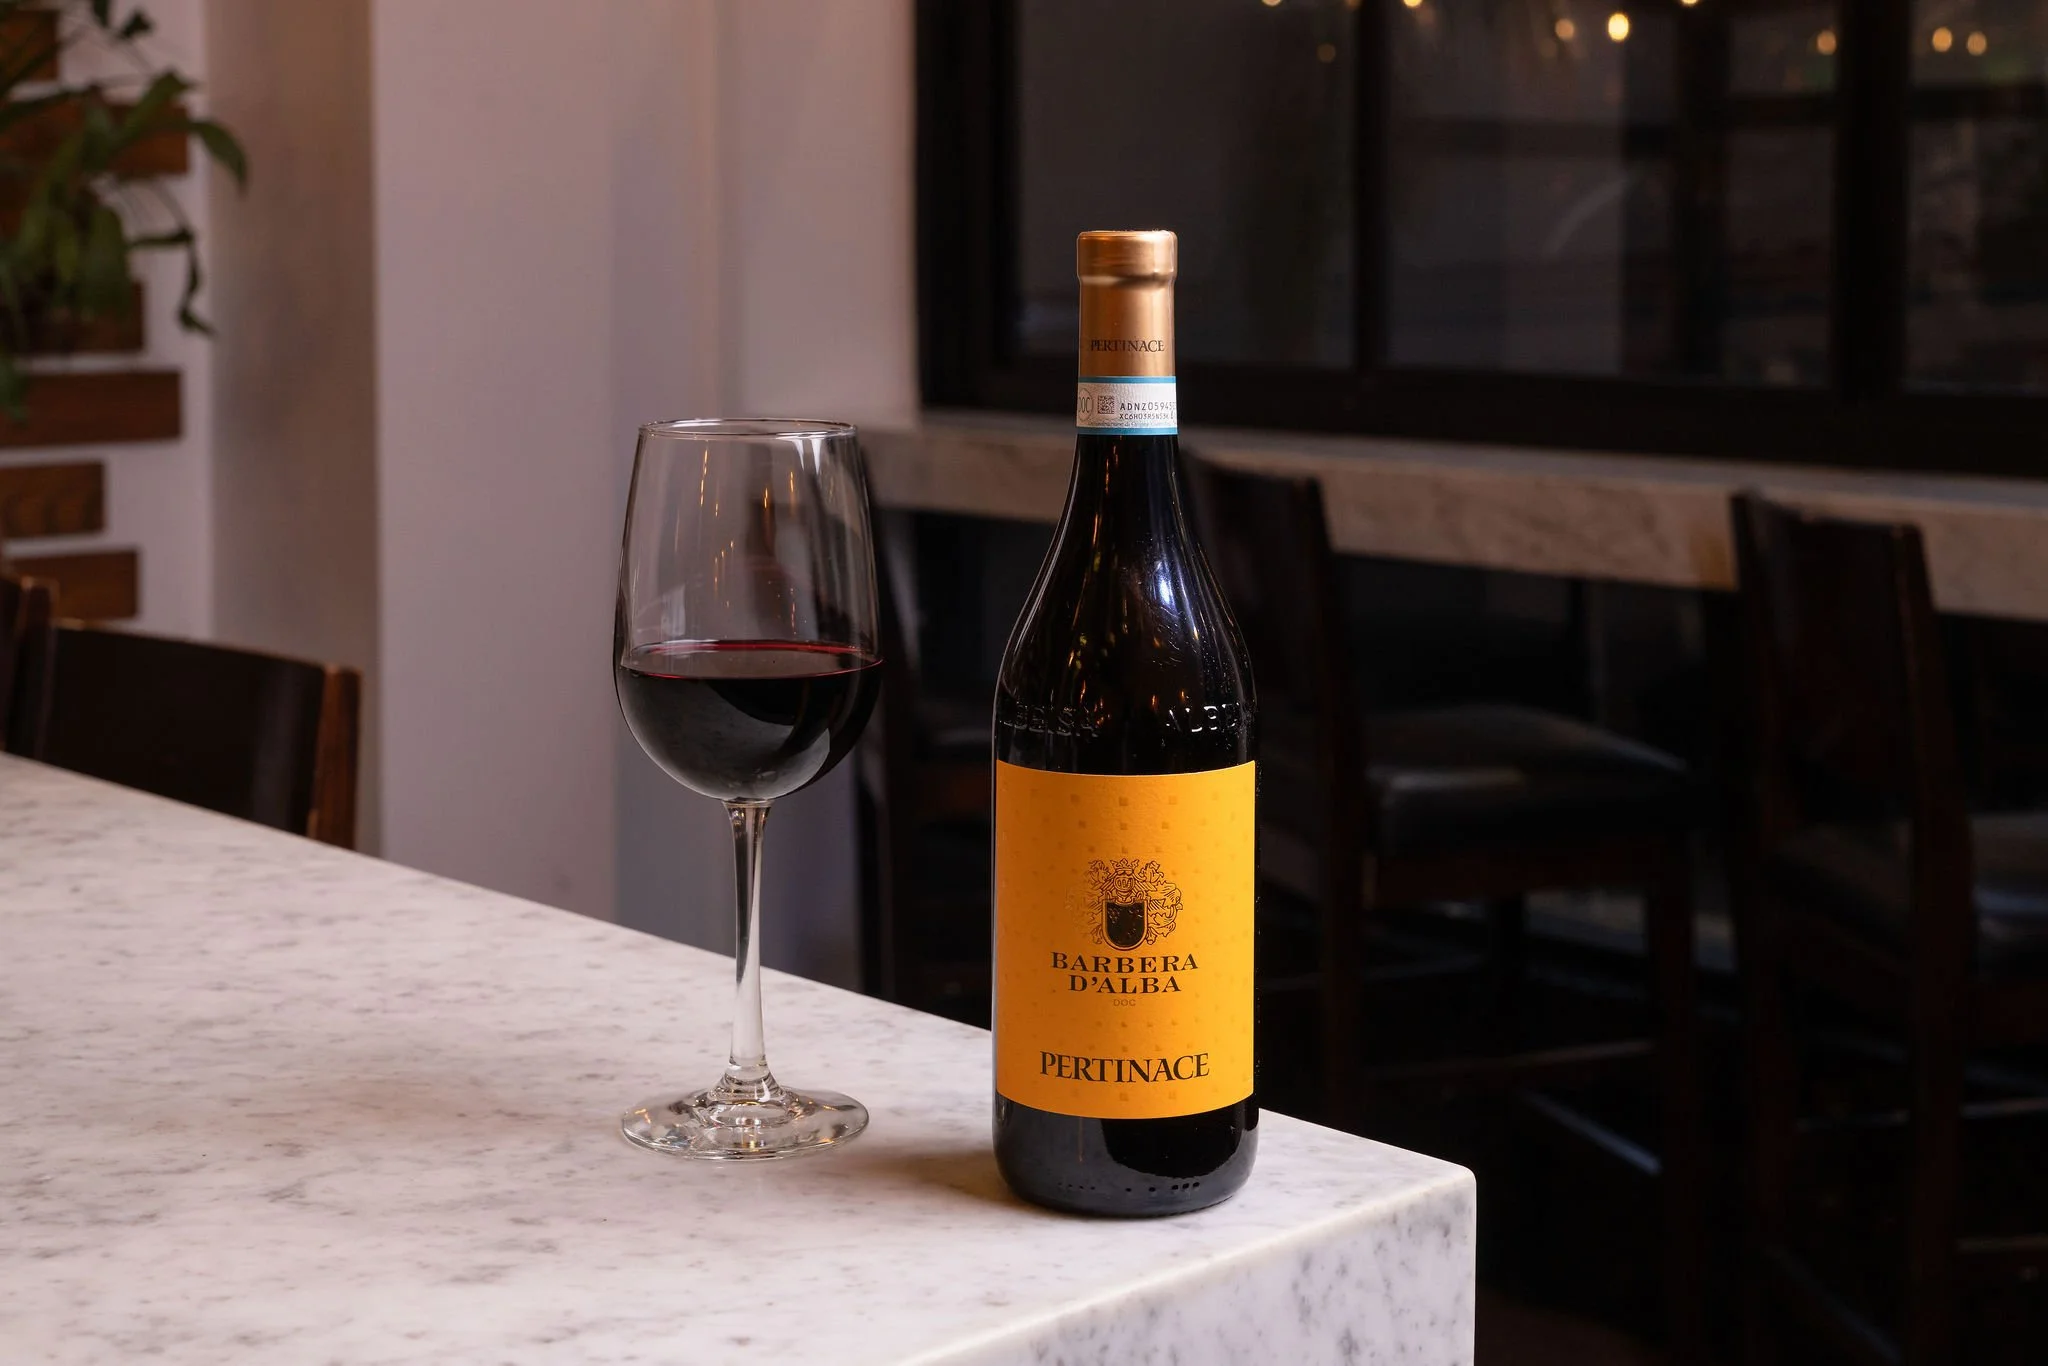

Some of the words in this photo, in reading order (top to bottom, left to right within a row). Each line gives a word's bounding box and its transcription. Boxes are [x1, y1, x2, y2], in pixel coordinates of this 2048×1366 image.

[1091, 340, 1165, 353] PERTINACE
[1050, 951, 1199, 974] BARBERA
[1113, 999, 1137, 1007] DOC
[1040, 1051, 1210, 1083] PERTINACE
